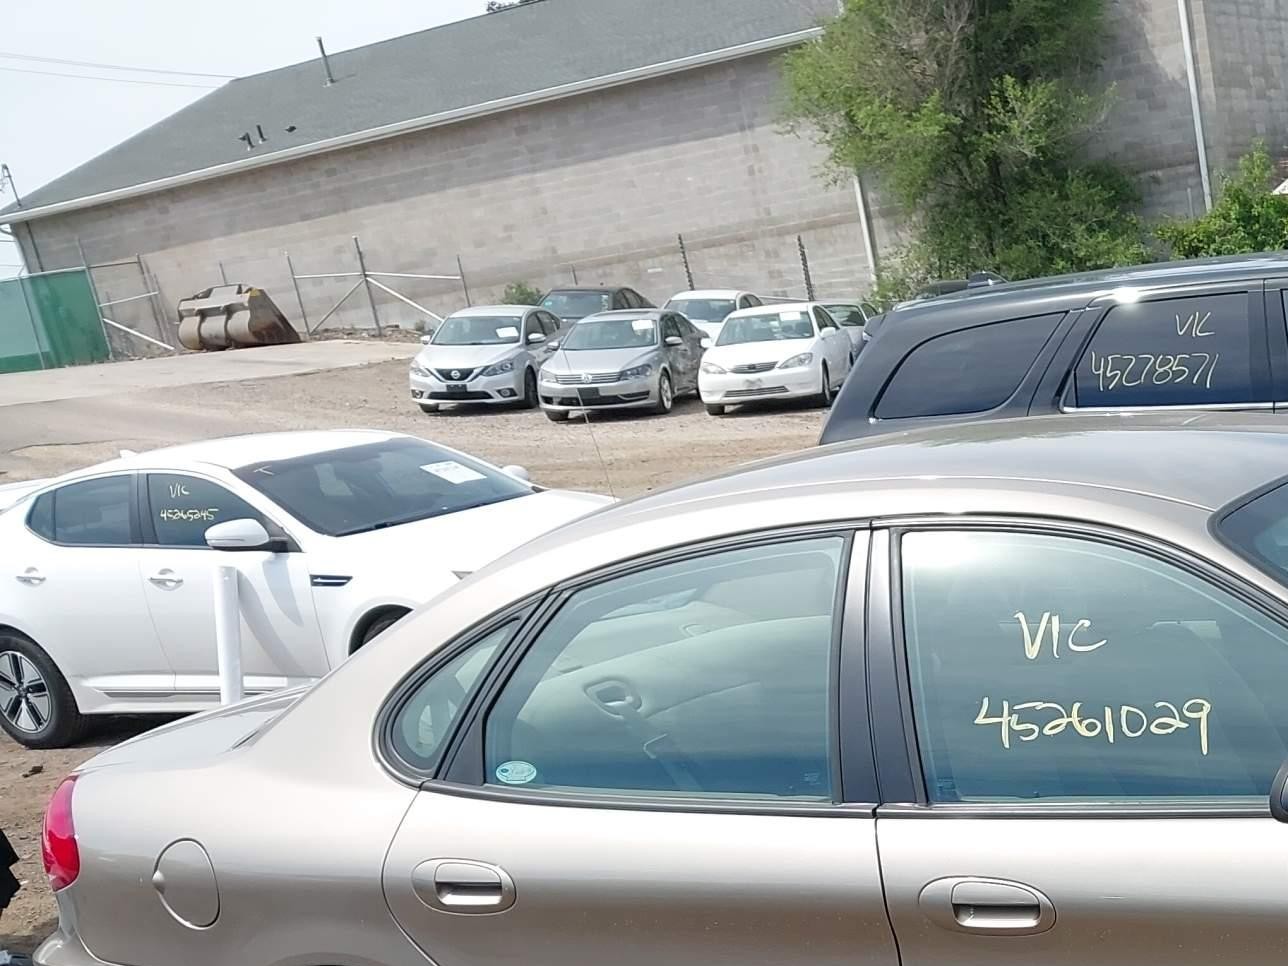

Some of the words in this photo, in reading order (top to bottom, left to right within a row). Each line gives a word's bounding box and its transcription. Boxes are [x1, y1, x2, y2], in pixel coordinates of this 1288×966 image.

[1091, 350, 1219, 392] 45278571
[1013, 611, 1107, 660] VIC
[974, 696, 1212, 755] 45261029
